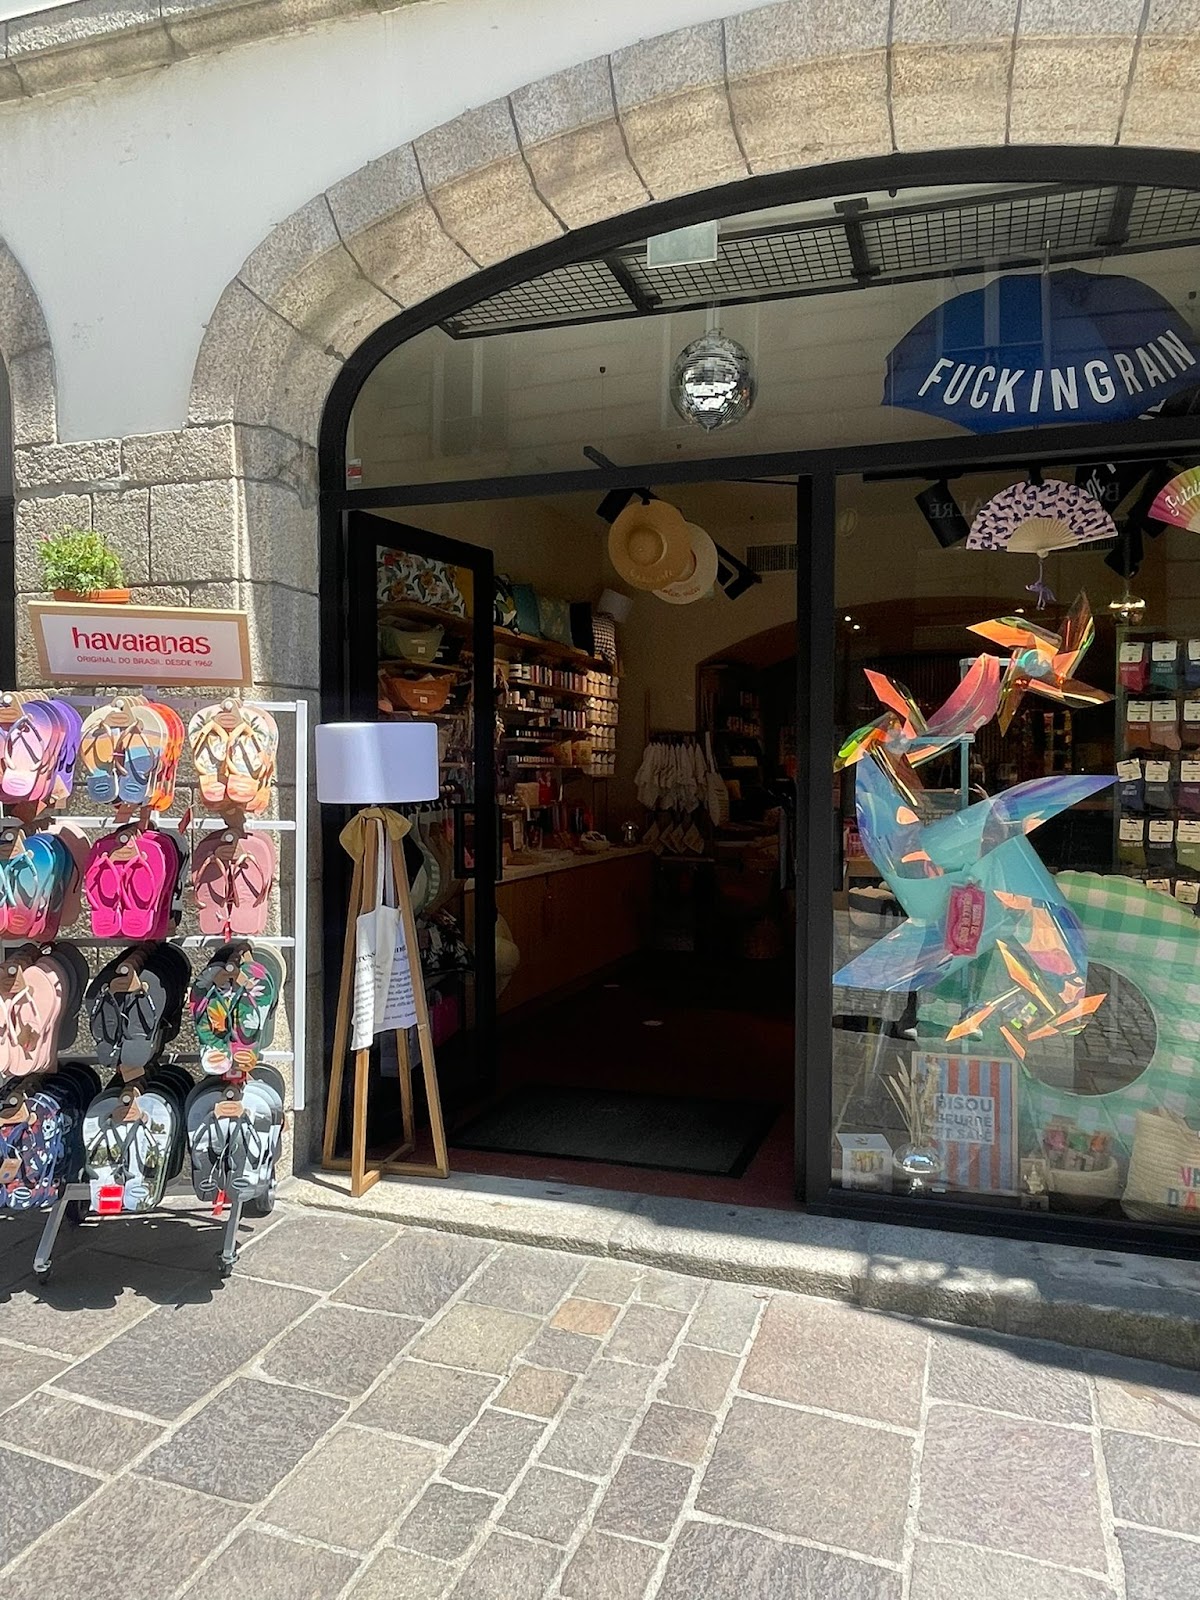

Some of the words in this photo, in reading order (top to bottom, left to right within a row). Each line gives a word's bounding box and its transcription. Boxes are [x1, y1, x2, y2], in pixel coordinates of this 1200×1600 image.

[72, 627, 211, 655] havaianas
[77, 655, 116, 664] ORIGINAL
[118, 657, 131, 665] DO
[133, 657, 163, 666] BRASIL
[165, 659, 192, 667] DESDE
[936, 1096, 992, 1112] BISOU
